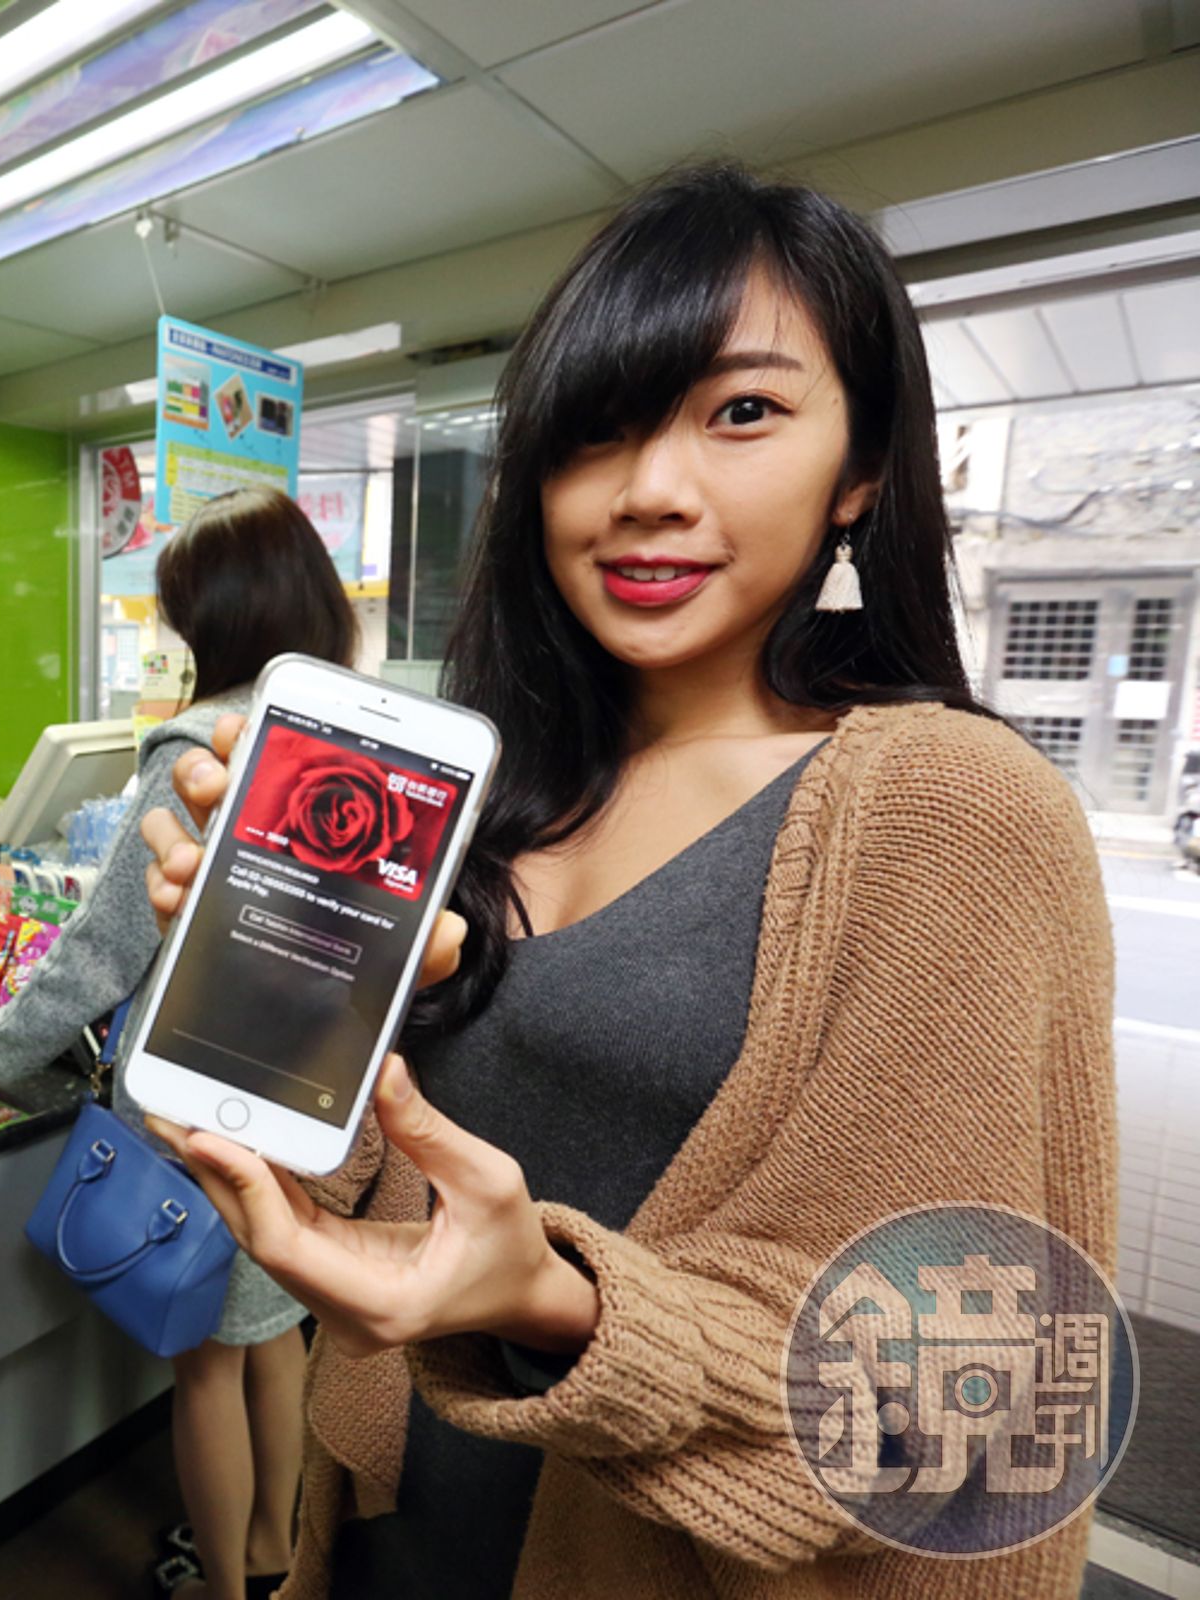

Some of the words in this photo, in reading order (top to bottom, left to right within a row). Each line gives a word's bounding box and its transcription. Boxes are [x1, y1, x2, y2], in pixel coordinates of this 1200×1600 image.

[226, 875, 252, 891] Apple
[376, 858, 418, 886] VISA
[316, 895, 339, 912] verify
[339, 906, 359, 918] your
[360, 911, 380, 925] card
[380, 918, 395, 929] for
